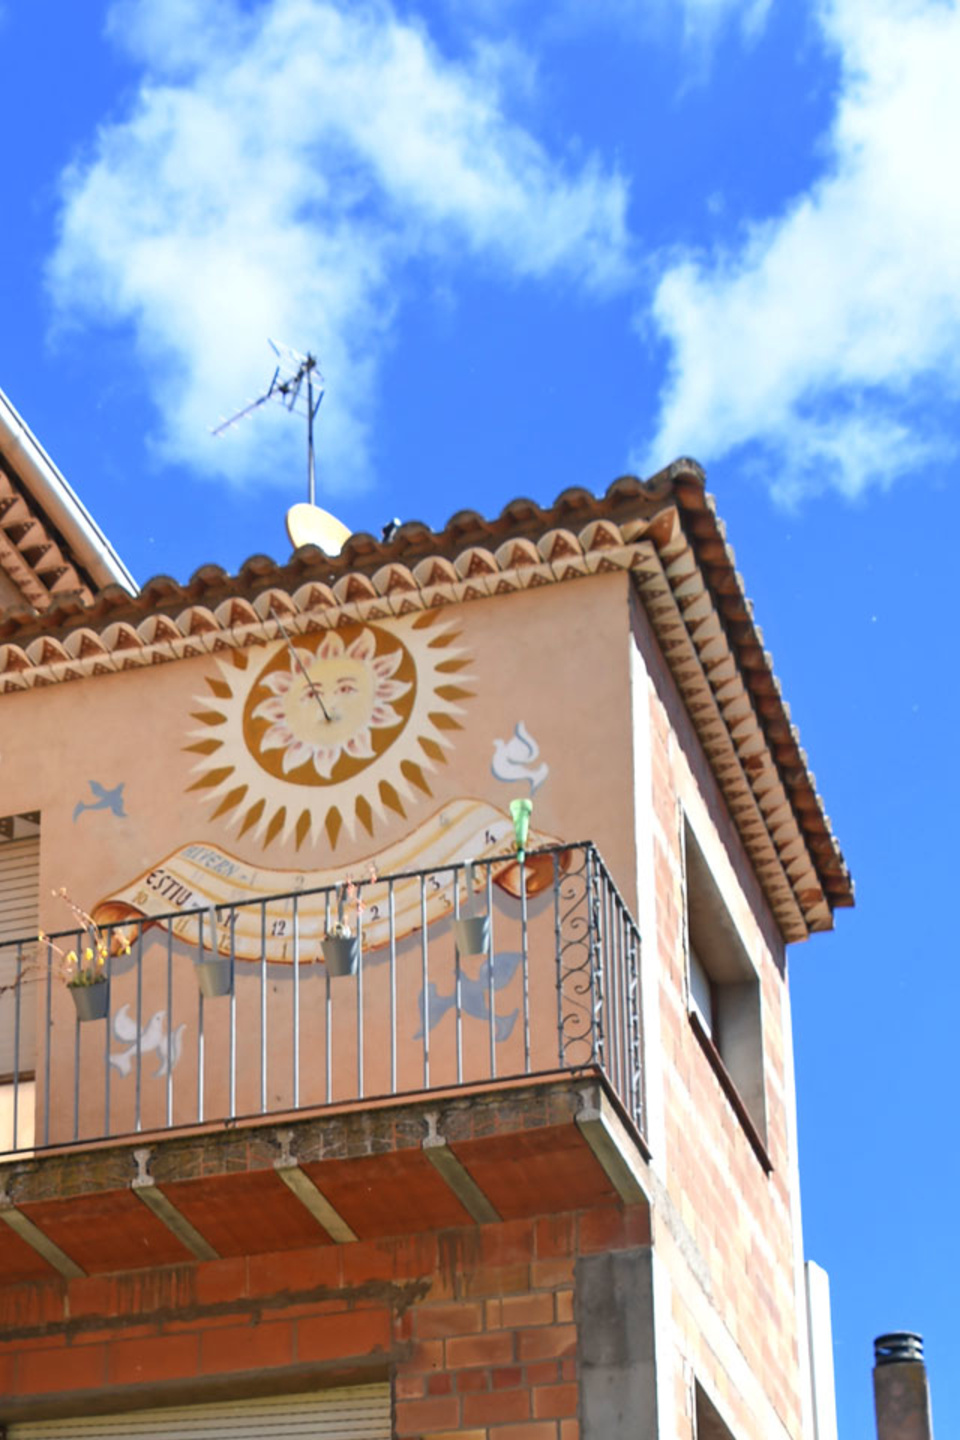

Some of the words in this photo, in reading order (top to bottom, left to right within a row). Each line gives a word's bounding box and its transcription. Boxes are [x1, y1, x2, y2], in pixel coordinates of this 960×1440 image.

[146, 869, 193, 906] ESTIU
[271, 920, 287, 937] 12
[369, 905, 381, 921] 2
[428, 875, 440, 891] 3
